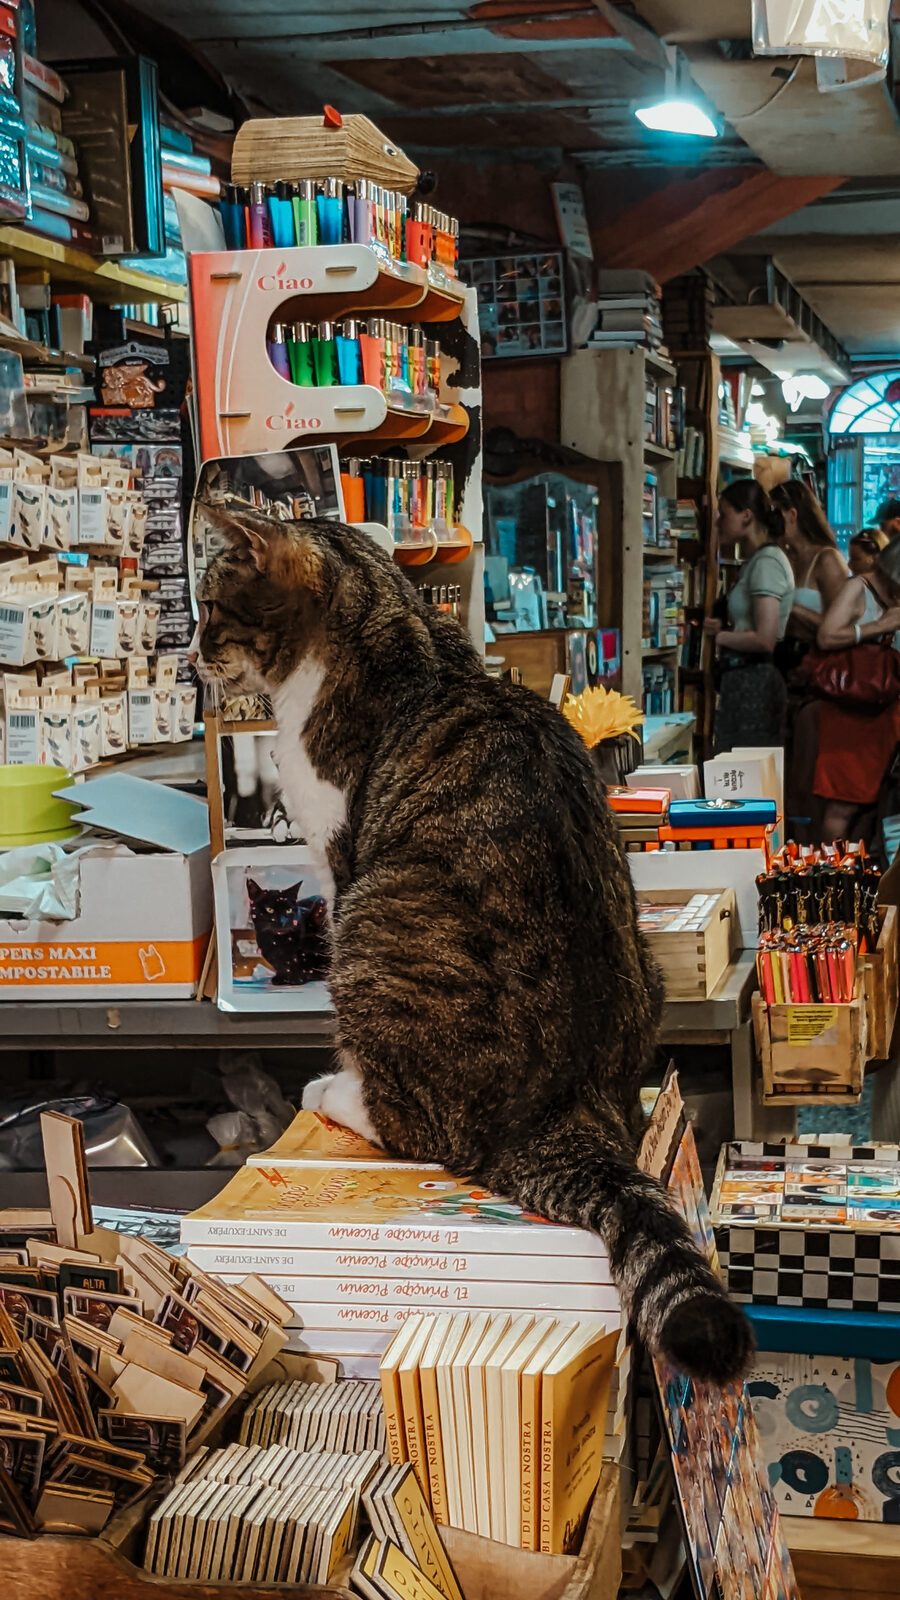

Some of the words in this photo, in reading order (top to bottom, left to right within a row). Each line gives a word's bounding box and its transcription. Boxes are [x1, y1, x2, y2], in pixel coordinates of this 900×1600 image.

[257, 267, 313, 291] Ciao
[265, 407, 321, 430] Ciao
[50, 947, 96, 960] MAXI
[207, 1227, 273, 1237] SAINT-EXUPÉRY
[275, 1229, 287, 1237] DE
[445, 1231, 459, 1245] El
[214, 1255, 280, 1265] SAINT-EXUPÉRY
[453, 1258, 467, 1272] El
[83, 1278, 106, 1290] ALTA
[453, 1287, 469, 1300] El
[388, 1412, 401, 1465] NOSTRA
[426, 1414, 438, 1465] NOSTRA
[523, 1420, 532, 1473] NOSTRA
[543, 1420, 552, 1472] NOSTRA
[431, 1473, 440, 1505] CASA
[523, 1481, 531, 1513] CASA
[542, 1481, 551, 1512] CASA
[523, 1520, 531, 1533] DI
[542, 1519, 550, 1532] DI
